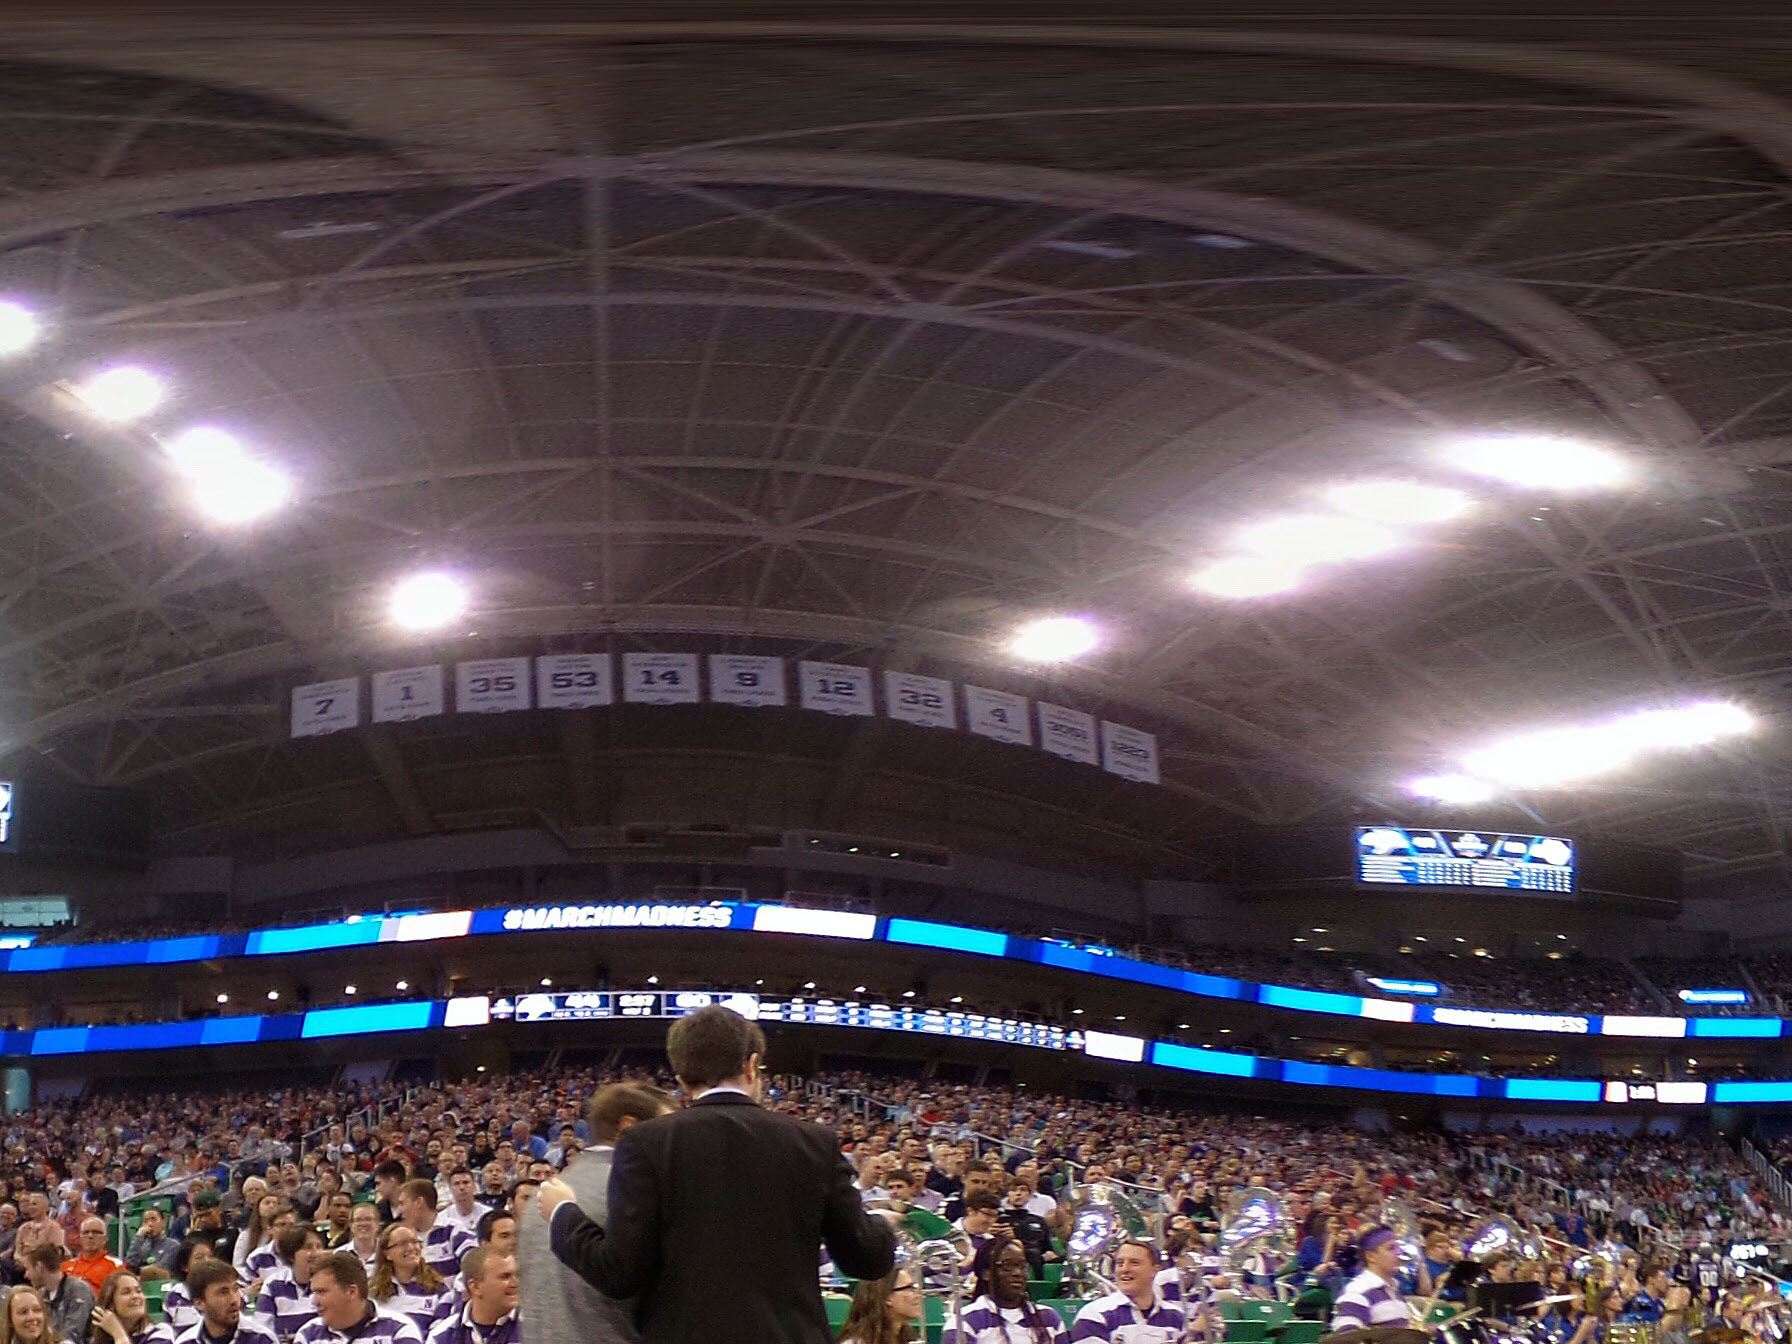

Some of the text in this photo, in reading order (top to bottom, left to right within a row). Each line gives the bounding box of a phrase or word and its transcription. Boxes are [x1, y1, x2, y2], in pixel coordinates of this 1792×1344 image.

[468, 676, 515, 693] 35
[552, 671, 597, 688] 53
[641, 668, 681, 686] 14
[401, 685, 415, 700] 1
[818, 678, 853, 696] 12
[314, 699, 334, 716] 7
[503, 905, 733, 930] #MARCHMADNESS
